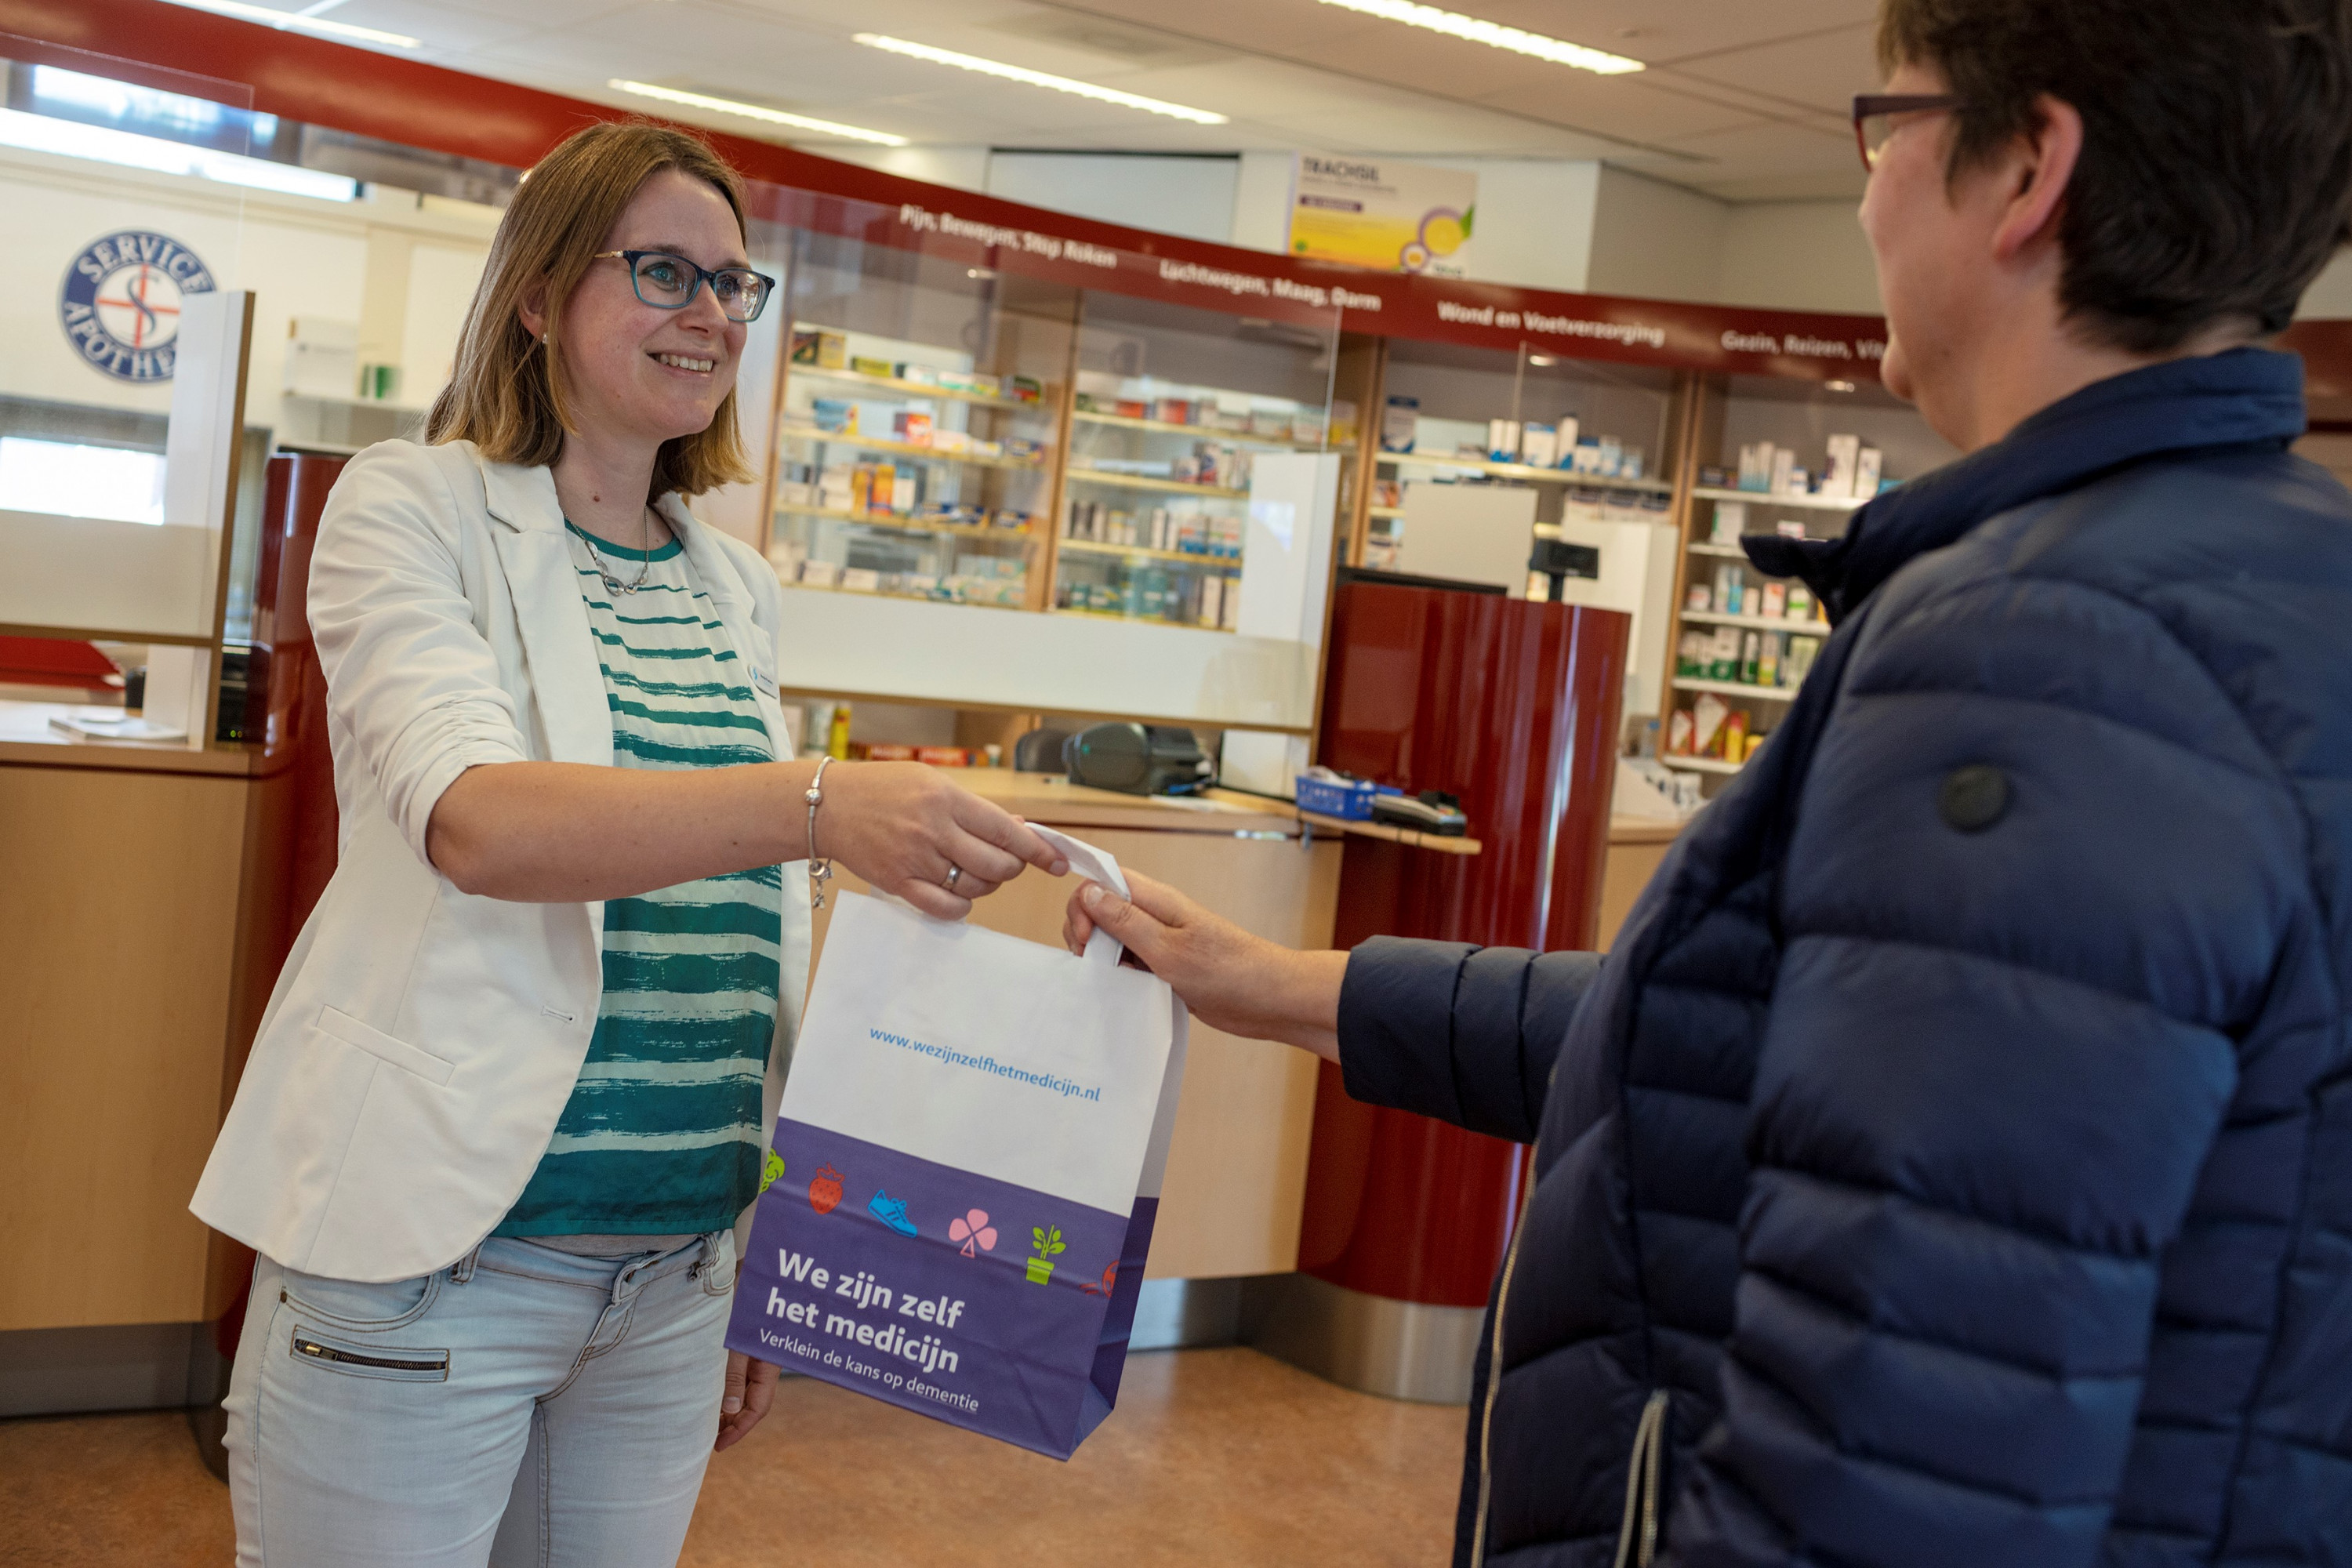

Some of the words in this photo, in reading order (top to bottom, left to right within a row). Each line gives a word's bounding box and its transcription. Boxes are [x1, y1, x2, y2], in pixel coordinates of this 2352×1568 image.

[78, 235, 210, 294] SERVICE
[939, 212, 1020, 249] Bewegen,
[1022, 231, 1062, 260] Stop
[1062, 240, 1117, 268] Roken
[1160, 258, 1269, 296] Luchtwegen,
[1272, 277, 1328, 307] Maag,
[1330, 286, 1381, 311] Darm
[1437, 300, 1494, 326] Wond
[1495, 310, 1521, 329] en
[1523, 310, 1665, 348] Voetverzorging
[869, 1028, 1102, 1102] www.wezijnzelfhetmedicijn.nl
[779, 1248, 830, 1289] We
[836, 1271, 893, 1309] zijn
[898, 1294, 965, 1329] zelf
[766, 1287, 819, 1328] het
[825, 1312, 959, 1373] medicijn
[760, 1328, 821, 1360] Verklein
[823, 1350, 843, 1367] de
[845, 1356, 880, 1380] kans
[884, 1370, 902, 1389] op
[906, 1377, 979, 1412] dementie
